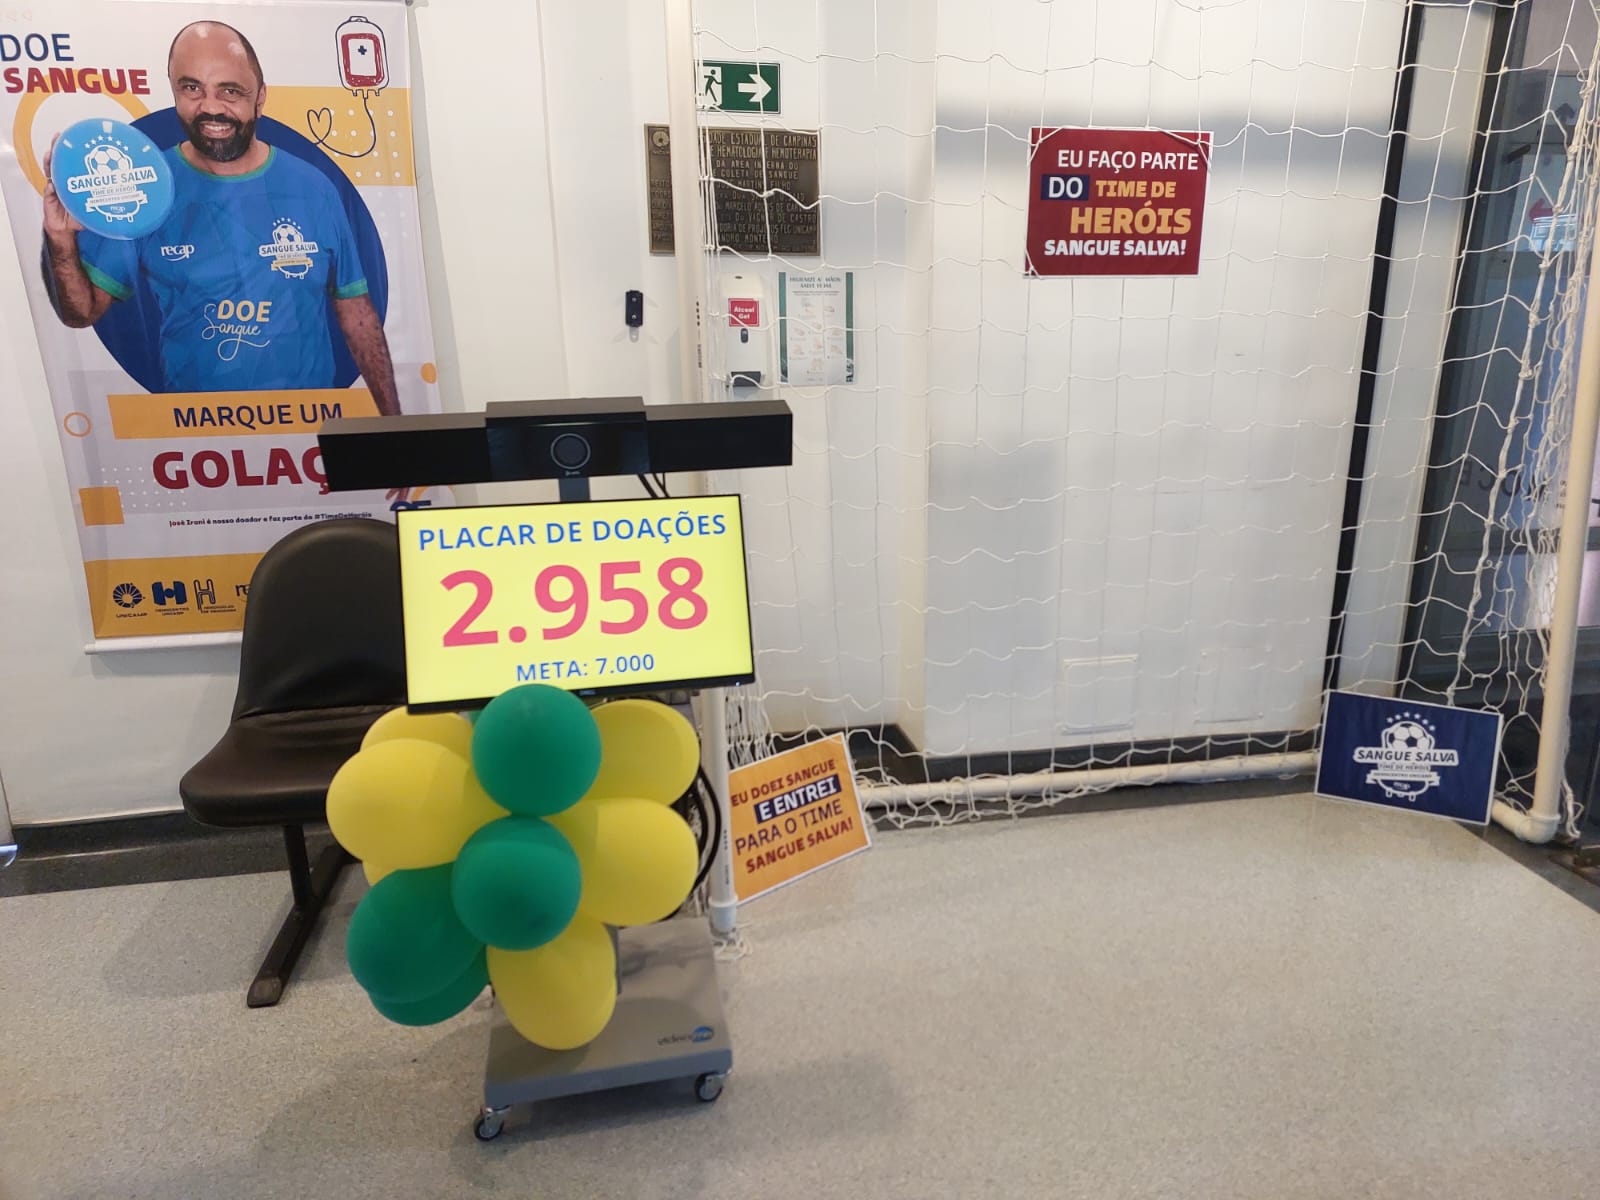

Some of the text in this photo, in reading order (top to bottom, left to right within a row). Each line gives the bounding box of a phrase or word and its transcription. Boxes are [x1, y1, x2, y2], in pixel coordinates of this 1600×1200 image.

[0, 33, 74, 62] DOE
[3, 67, 151, 95] SANGUE
[784, 135, 817, 148] CAMPINAS
[754, 160, 785, 169] INERNA
[1057, 150, 1199, 174] EU FAÇO PARTE
[70, 169, 154, 190] SANGUE SALVA
[1048, 176, 1177, 198] DO TIME DE
[1070, 200, 1192, 234] HERÓIS
[160, 244, 195, 260] recap
[261, 243, 317, 255] SANGUE SALVA
[1044, 239, 1187, 256] SANGUE SALVA!
[217, 299, 273, 323] DOE
[173, 403, 342, 430] MARQUE UM
[152, 446, 331, 495] GOLAÇ
[419, 510, 727, 551] PLACAR DE DOAÇÕES
[439, 557, 709, 648] 2.958
[516, 653, 655, 682] META: 7.000
[1357, 750, 1456, 763] SANGUE SALVA
[730, 759, 837, 808] EU DOEI SANGUE
[758, 777, 838, 821] E ENTREI
[735, 824, 783, 856] PARA
[784, 817, 797, 835] O
[799, 798, 844, 829] TIME
[745, 837, 806, 874] SANGUE
[807, 816, 854, 847] SALVA!
